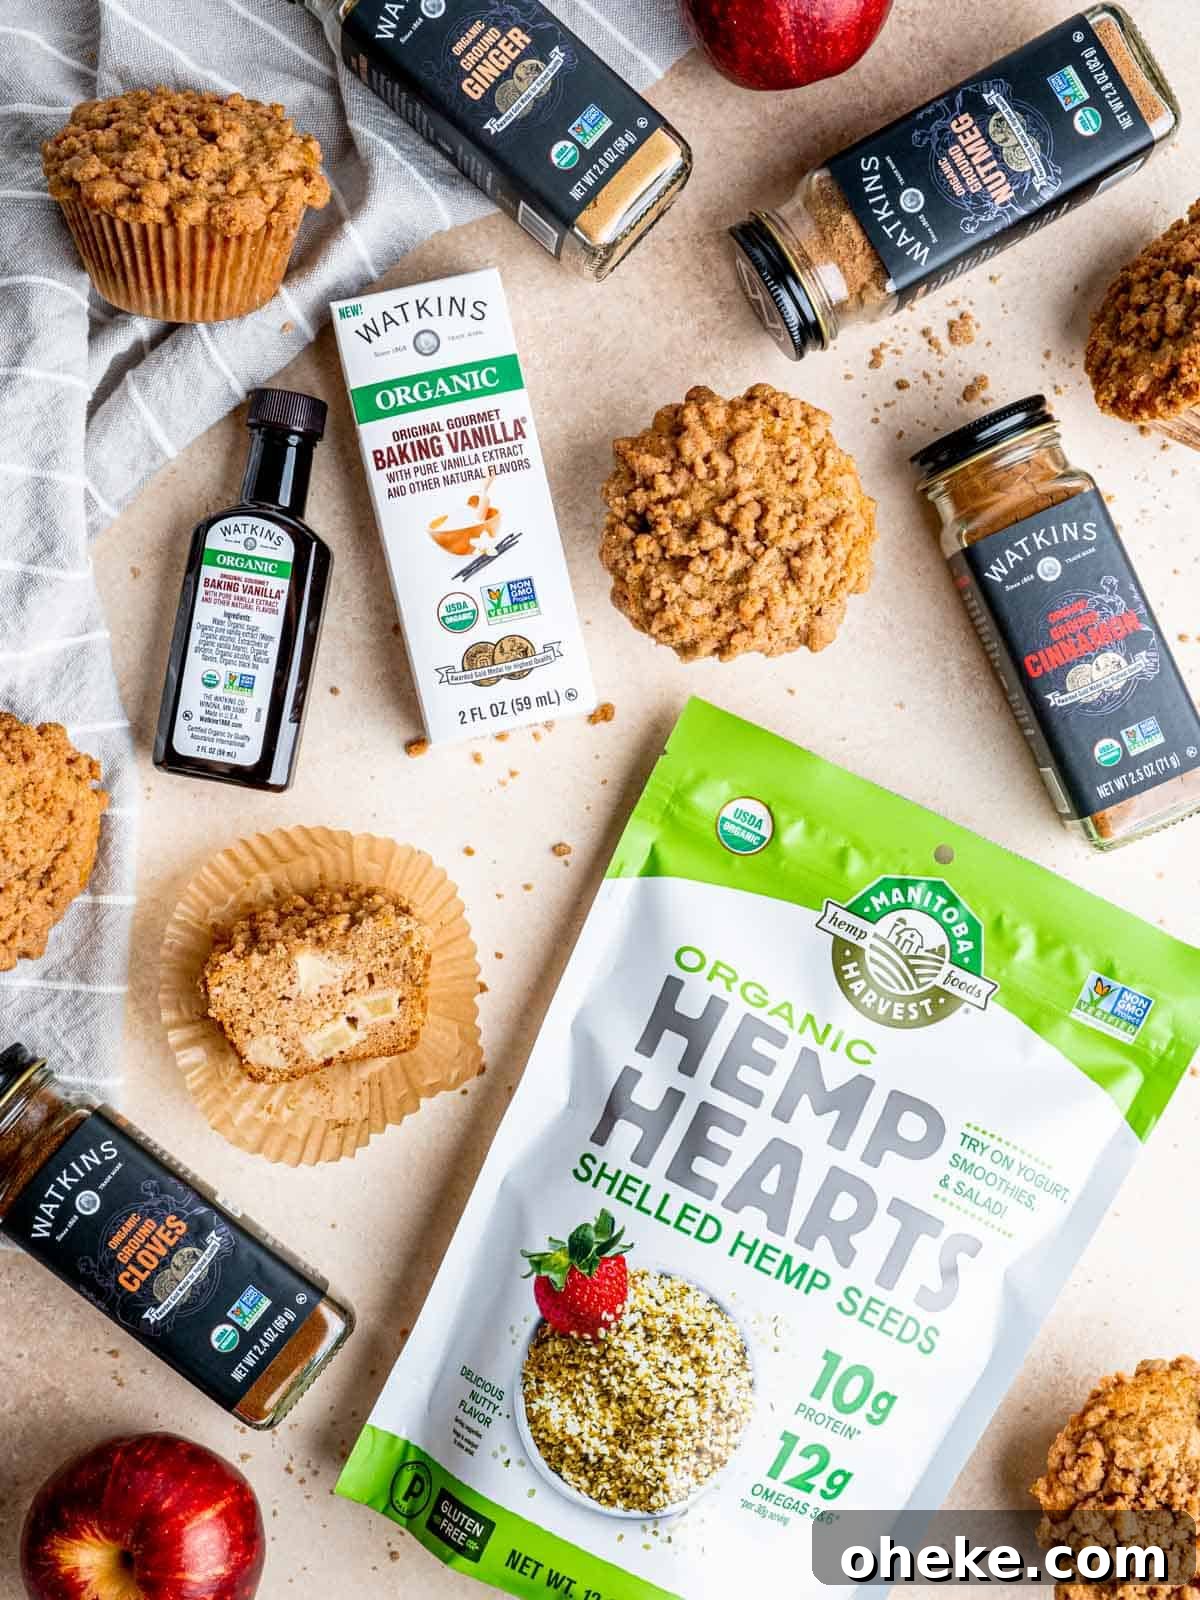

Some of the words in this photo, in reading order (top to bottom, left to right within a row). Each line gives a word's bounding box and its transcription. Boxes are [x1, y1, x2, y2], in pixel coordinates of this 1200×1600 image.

[452, 19, 486, 57] ORGANIC
[459, 27, 502, 72] GROUND
[1080, 46, 1097, 60] g)
[461, 25, 532, 101] GINGER
[1093, 70, 1109, 85] OZ
[1108, 97, 1125, 114] WT
[1115, 113, 1135, 130] NET
[569, 181, 588, 201] NET
[581, 169, 599, 187] WT
[602, 148, 619, 164] OZ
[625, 128, 638, 145] g)
[938, 157, 966, 197] ORGANIC
[949, 144, 982, 193] GROUND
[951, 112, 1015, 206] NUTMEG
[861, 156, 930, 266] WATKINS
[338, 303, 364, 321] NEW!
[354, 296, 488, 345] WATKINS
[375, 367, 500, 411] ORGANIC
[392, 421, 445, 442] ORIGINAL
[446, 409, 501, 430] GOURMET
[372, 436, 444, 471] BAKING
[386, 468, 412, 483] WITH
[413, 463, 439, 480] PURE
[440, 453, 481, 474] VANILLA
[482, 443, 525, 464] EXTRACT
[387, 484, 407, 499] AND
[409, 477, 441, 495] OTHER
[442, 469, 486, 489] NATURAL
[487, 458, 532, 478] FLAVORS
[219, 523, 284, 547] WATKINS
[984, 521, 1098, 583] WATKINS
[216, 554, 278, 574] ORGANIC
[203, 578, 238, 592] BAKING
[256, 599, 278, 607] EXTRACT
[509, 580, 531, 590] NON
[511, 586, 533, 596] GMO
[445, 601, 467, 612] USDA
[458, 710, 467, 724] 2
[470, 706, 485, 721] FL
[489, 701, 507, 717] OZ
[510, 695, 532, 715] (59
[534, 689, 560, 709] mL)
[1097, 781, 1116, 800] NET
[1114, 774, 1130, 790] WT
[1128, 769, 1144, 785] 2.5
[1143, 762, 1158, 778] OZ
[1155, 756, 1170, 775] (71
[1168, 752, 1181, 769] g)
[722, 821, 761, 847] ORGANIC
[733, 807, 764, 832] USDA
[828, 911, 869, 941] hemp
[869, 886, 974, 955] MANITOBA
[841, 962, 933, 1021] HARVEST
[942, 970, 982, 999] foods
[1121, 990, 1149, 1010] NON
[674, 945, 878, 1067] ORGANIC
[1077, 999, 1137, 1035] VERIFIED
[1117, 1000, 1145, 1018] GMO
[635, 974, 946, 1169] HEMP
[948, 1152, 1038, 1212] SMOOTHIES,
[959, 1132, 991, 1156] TRY
[990, 1149, 1015, 1171] ON
[1015, 1161, 1071, 1204] YOGURT,
[31, 1140, 119, 1239] WATKINS
[589, 1065, 983, 1313] HEARTS
[938, 1173, 954, 1190] &
[953, 1178, 1010, 1219] SALAD!
[107, 1212, 142, 1250] ORGANIC
[116, 1218, 158, 1265] GROUND
[117, 1214, 188, 1294] CLOVES
[572, 1152, 723, 1246] SHELLED
[727, 1230, 832, 1296] HEMP
[836, 1285, 941, 1356] SEEDS
[230, 1362, 249, 1383] NET
[242, 1350, 260, 1367] WT
[254, 1338, 271, 1355] 2.4
[263, 1328, 279, 1342] OZ
[272, 1315, 288, 1333] (69
[284, 1306, 297, 1324] g)
[460, 1365, 505, 1401] DELICIOUS
[469, 1389, 500, 1414] NUTTY
[809, 1348, 899, 1427] 10g
[458, 1399, 493, 1428] FLAVOR
[766, 1430, 854, 1501] 12g
[440, 1499, 486, 1538] GLUTEN
[751, 1482, 810, 1516] OMEGAS
[439, 1519, 468, 1548] FREE
[504, 1548, 545, 1581] NET
[546, 1568, 577, 1599] WT.
